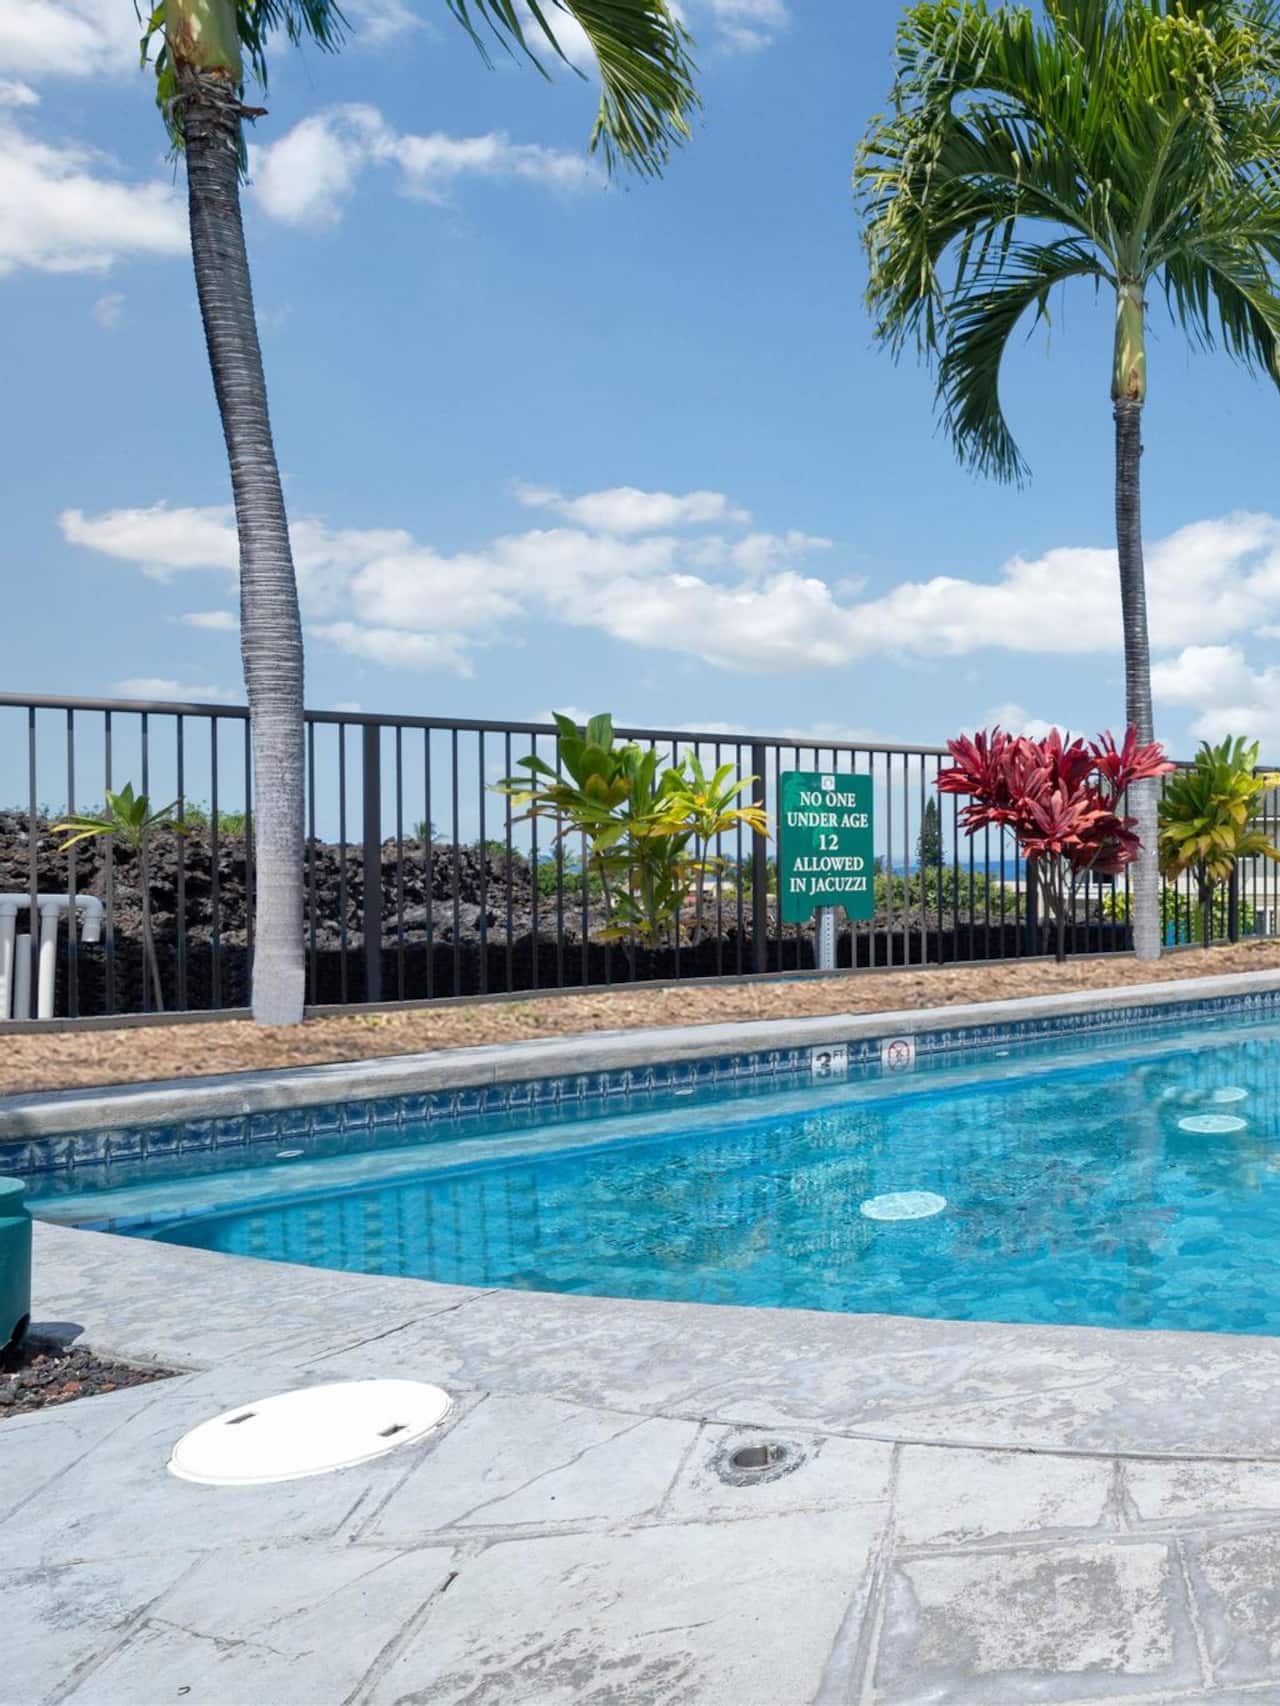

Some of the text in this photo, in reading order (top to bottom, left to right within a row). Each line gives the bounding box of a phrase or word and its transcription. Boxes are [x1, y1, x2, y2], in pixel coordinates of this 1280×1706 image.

[800, 791, 856, 807] NO ONE
[787, 812, 869, 828] UNDER AGE
[819, 834, 839, 850] 12
[793, 856, 865, 871] ALLOWED
[790, 877, 867, 895] IN JACUZZI
